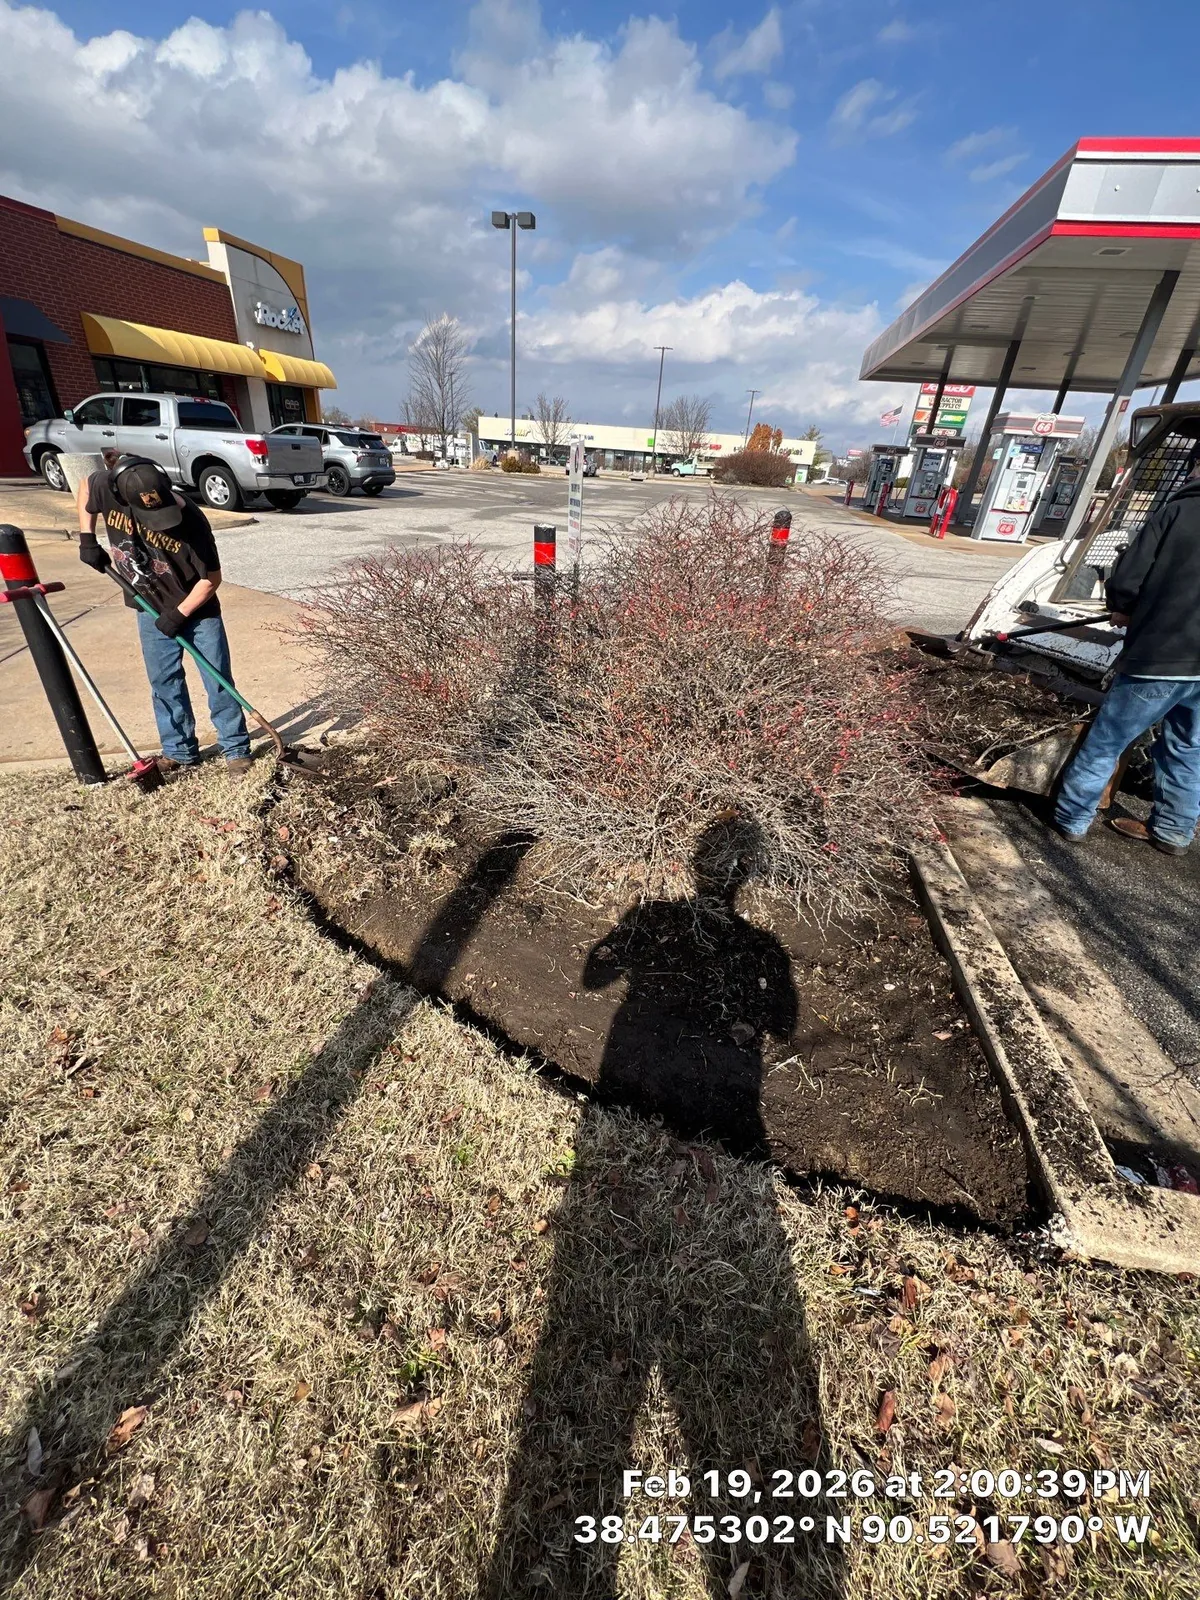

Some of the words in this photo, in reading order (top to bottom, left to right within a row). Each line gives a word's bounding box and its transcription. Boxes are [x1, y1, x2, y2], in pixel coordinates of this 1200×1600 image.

[254, 302, 304, 335] iRocket
[1037, 423, 1052, 432] 66
[107, 510, 134, 535] GUNS
[145, 530, 181, 554] ROSES
[999, 525, 1013, 533] 66
